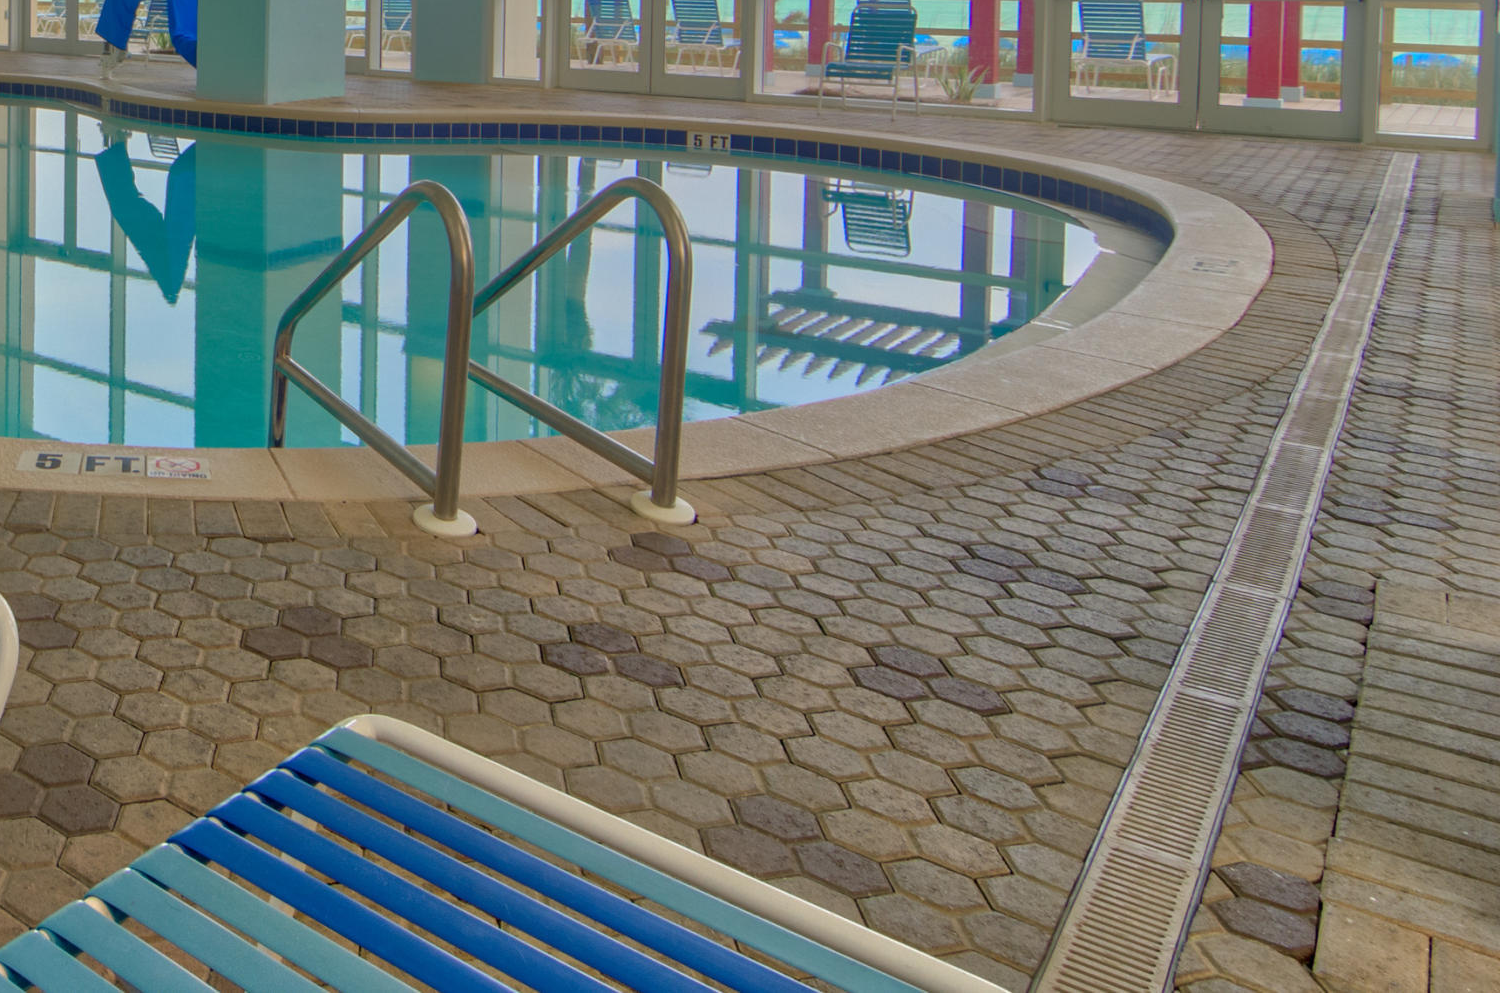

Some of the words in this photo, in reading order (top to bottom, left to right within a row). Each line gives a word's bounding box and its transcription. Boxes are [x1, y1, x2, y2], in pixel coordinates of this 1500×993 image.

[694, 135, 703, 147] 5
[711, 135, 729, 148] FT
[35, 453, 63, 470] 5
[85, 456, 141, 473] FT.
